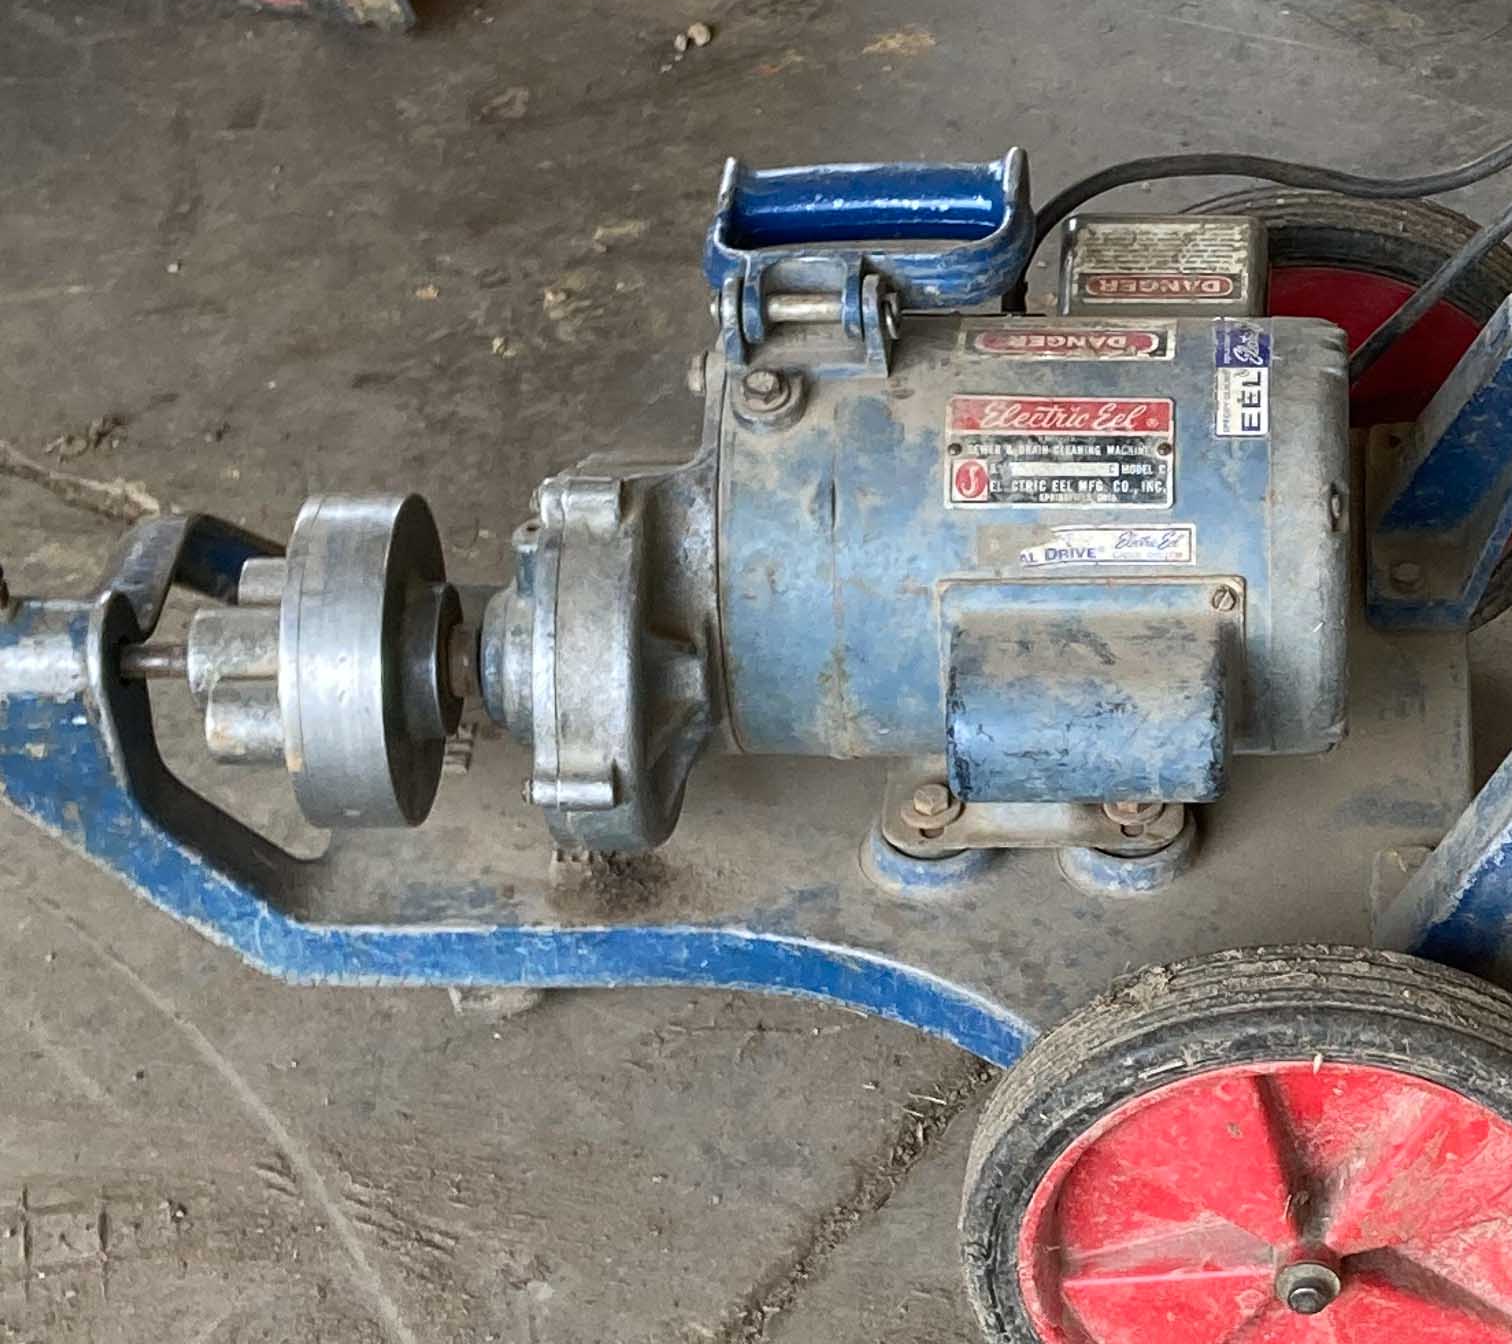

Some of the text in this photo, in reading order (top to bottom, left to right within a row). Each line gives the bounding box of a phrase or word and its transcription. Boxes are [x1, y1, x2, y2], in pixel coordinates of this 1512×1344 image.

[1099, 279, 1221, 293] DANGER
[1007, 335, 1128, 348] DANGER
[1241, 371, 1261, 432] EEL
[980, 400, 1147, 430] Electric Eel
[1052, 444, 1102, 455] CLEANING
[1121, 463, 1153, 475] MODEL
[990, 479, 1047, 494] ELCTRIC
[1052, 479, 1073, 492] EEL
[1045, 547, 1097, 561] DRIVE
